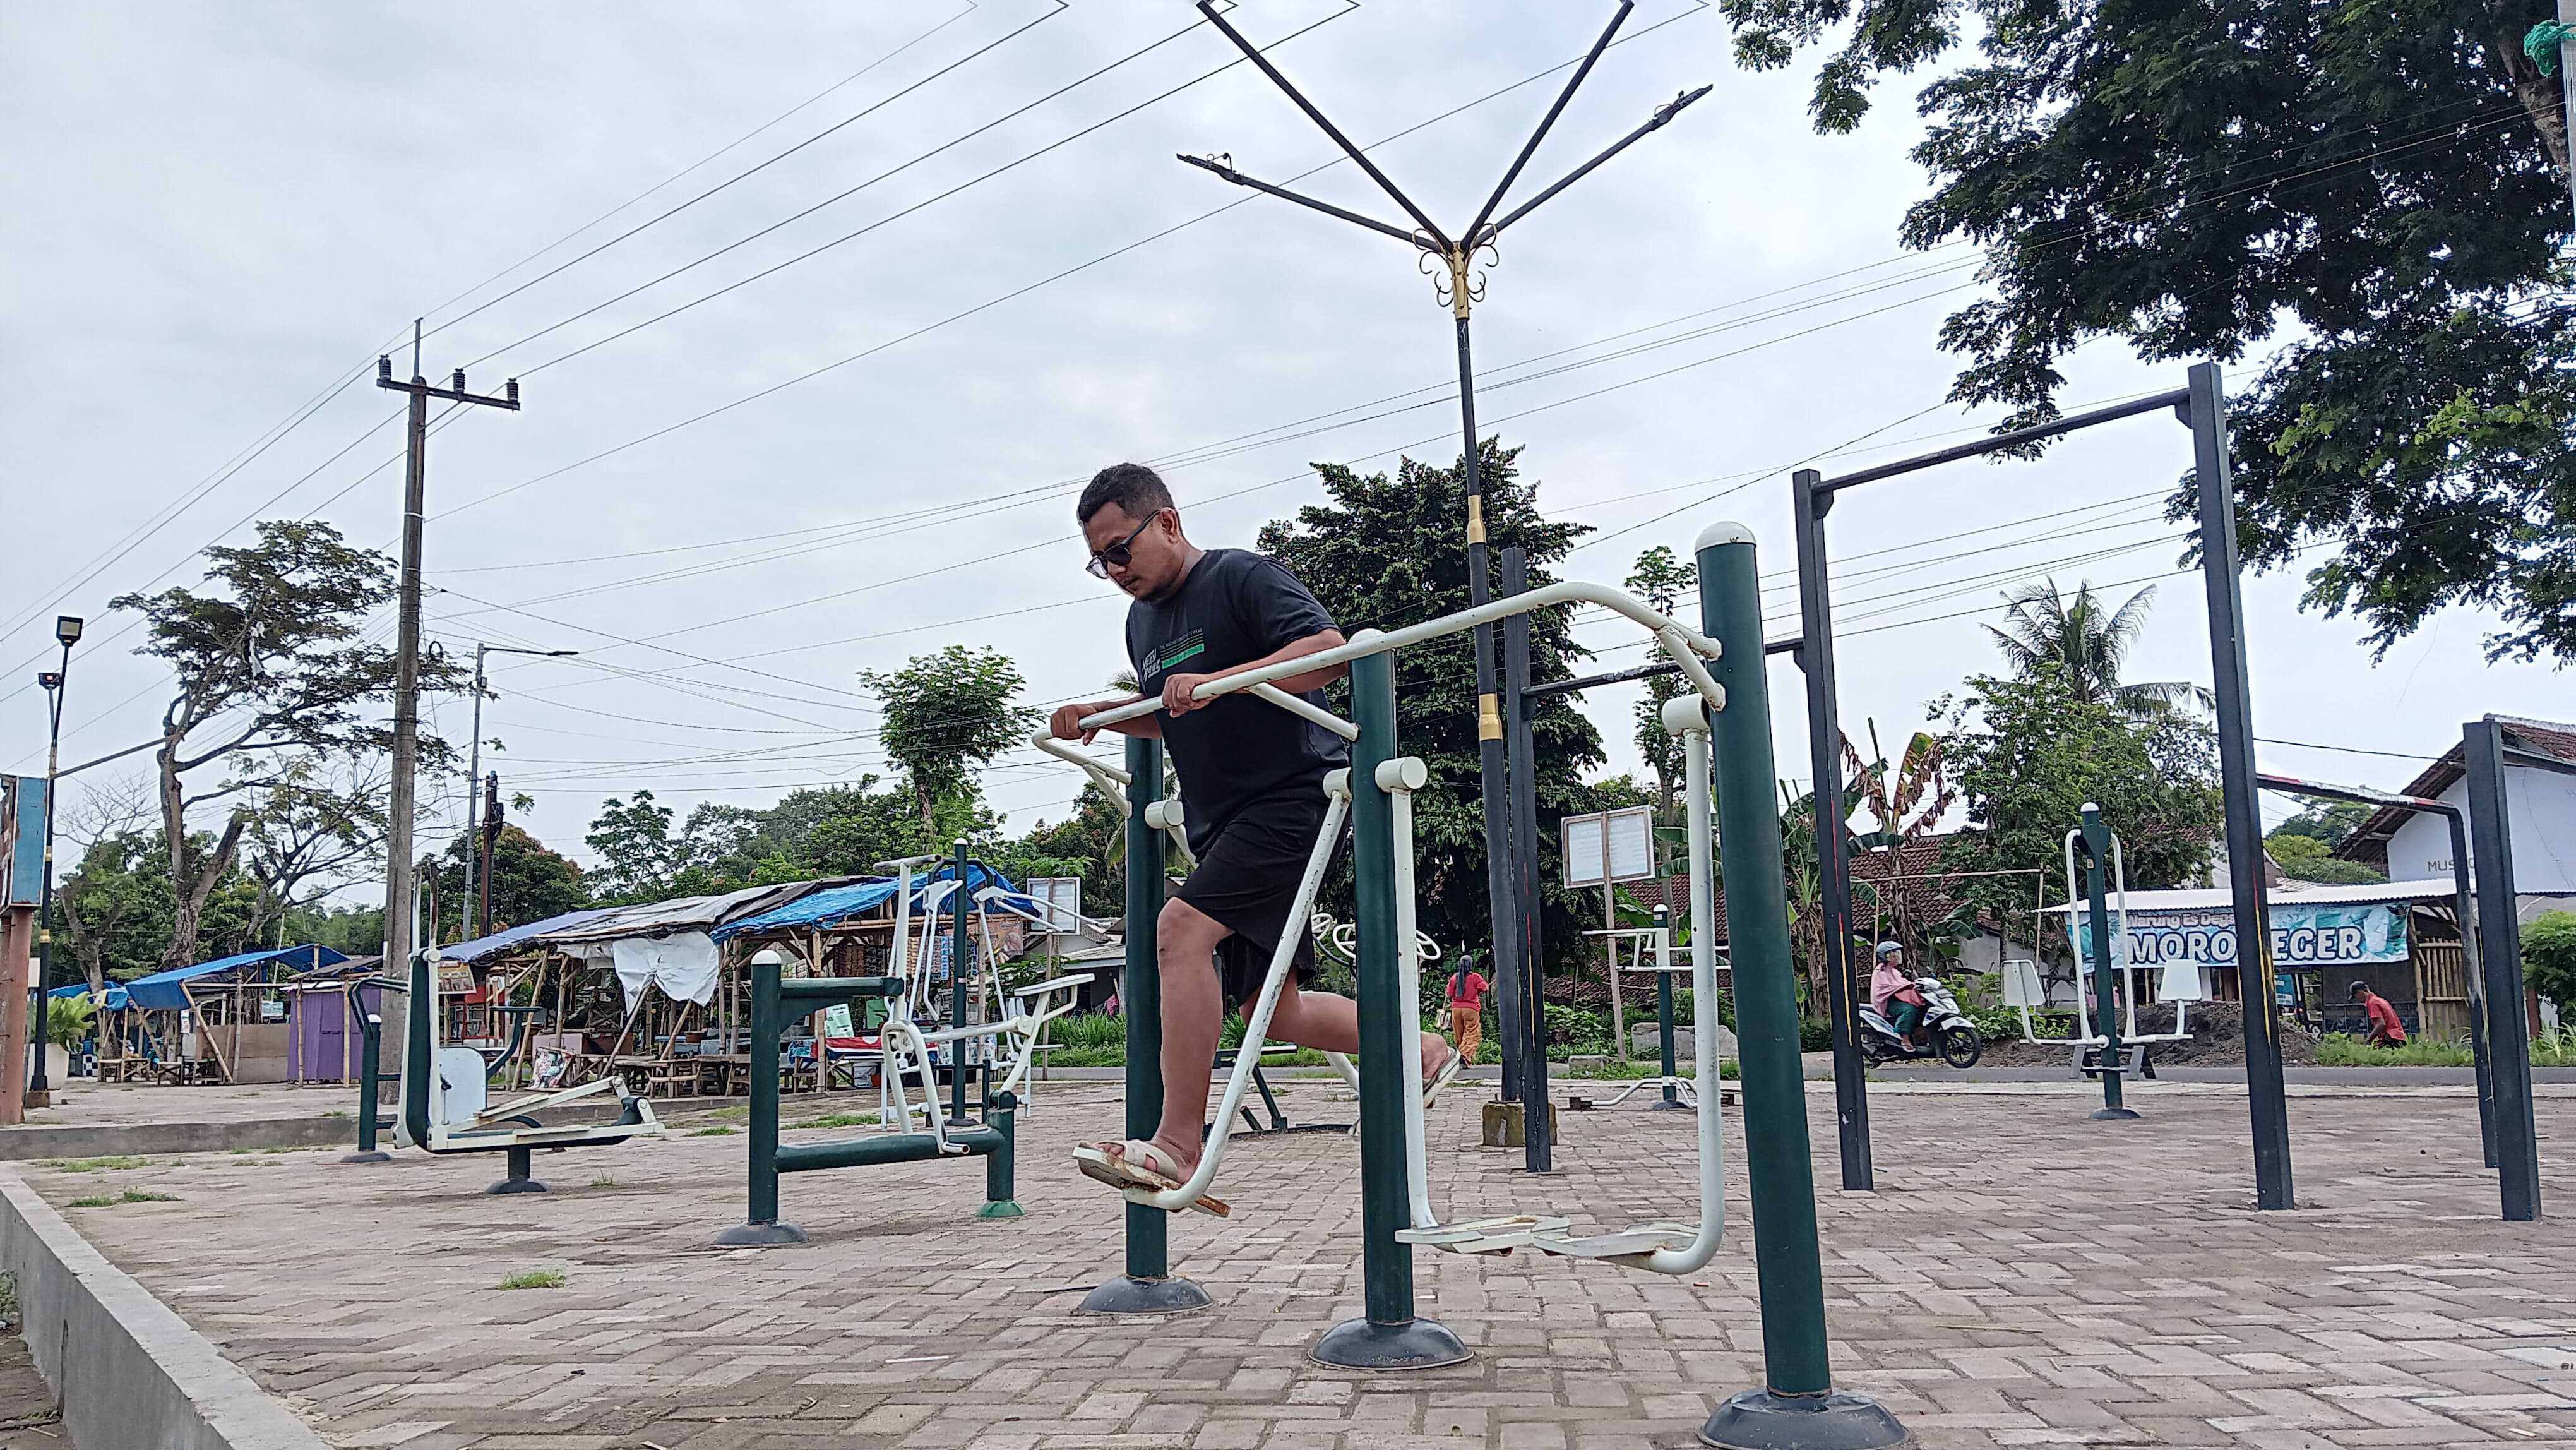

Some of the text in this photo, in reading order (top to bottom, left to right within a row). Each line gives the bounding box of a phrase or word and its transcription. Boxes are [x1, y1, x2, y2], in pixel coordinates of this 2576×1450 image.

[2182, 912, 2199, 927] Es
[2200, 911, 2235, 928] Dega
[2128, 926, 2363, 964] MORO EGER
